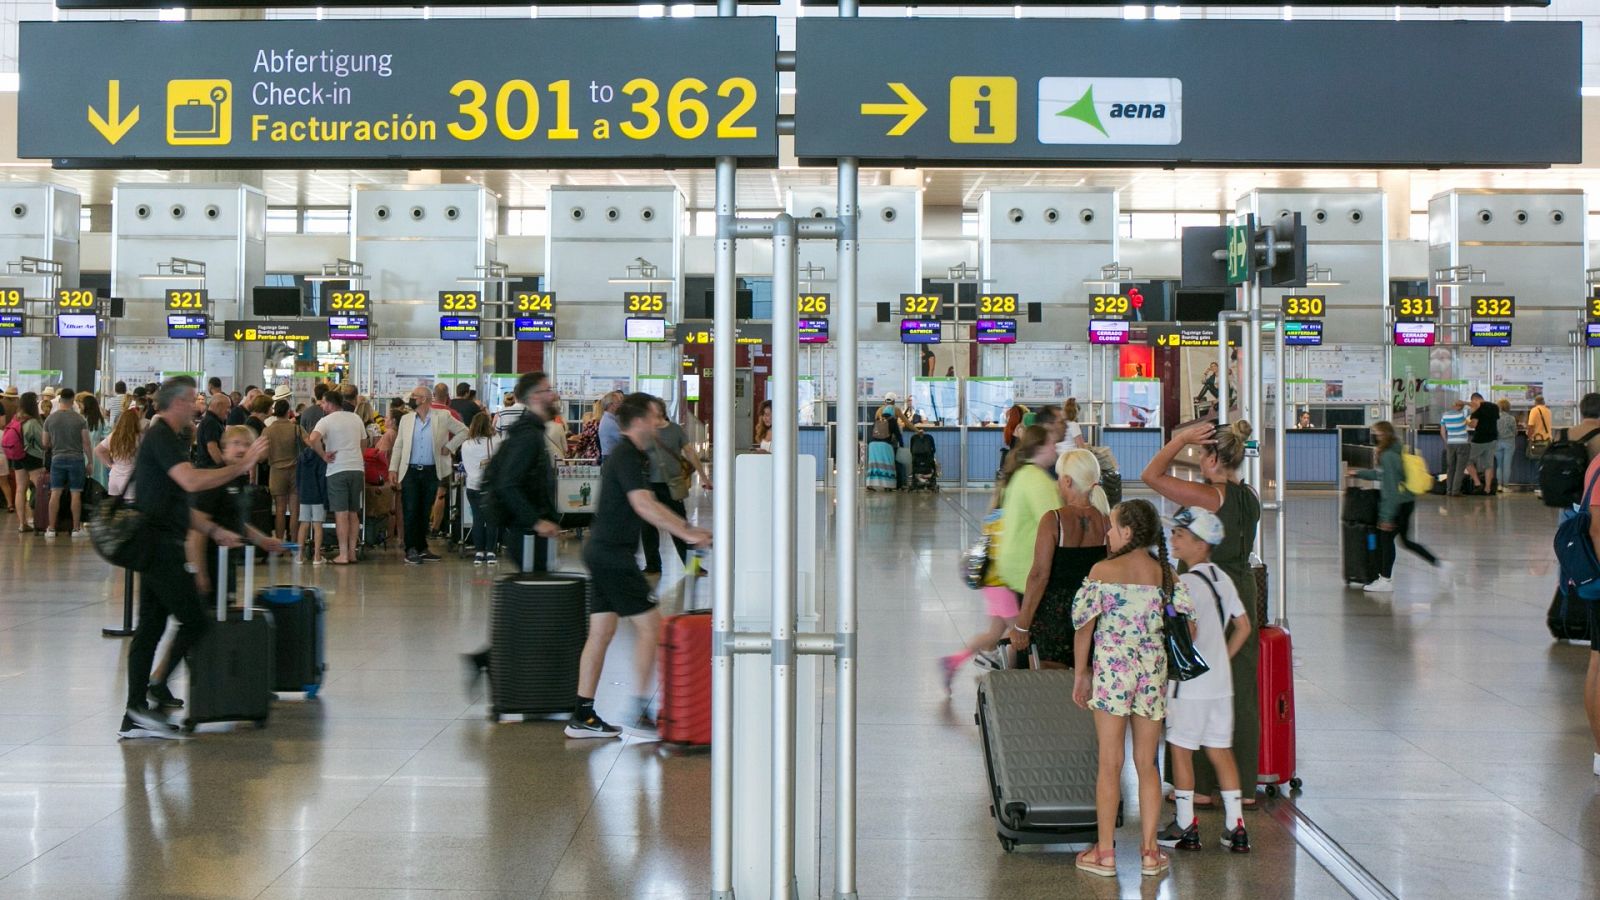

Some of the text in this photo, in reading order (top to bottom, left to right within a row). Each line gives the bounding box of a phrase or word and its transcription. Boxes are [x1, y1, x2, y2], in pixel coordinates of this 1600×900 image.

[253, 48, 393, 78] Abfertigung
[252, 81, 352, 106] Check-in
[589, 80, 614, 103] to
[446, 79, 579, 141] 301
[618, 77, 758, 141] 362
[1109, 103, 1166, 120] aena
[251, 114, 436, 142] Facturación
[591, 119, 610, 141] a
[0, 290, 20, 308] 19
[59, 291, 95, 308] 320
[169, 291, 203, 309] 321
[331, 293, 366, 311] 322
[443, 294, 478, 311] 323
[517, 294, 553, 312] 324
[629, 295, 664, 312] 325
[904, 296, 939, 314] 327
[980, 296, 1016, 314] 328
[1093, 296, 1129, 314] 329
[1287, 298, 1323, 315] 330
[1399, 298, 1434, 316] 331
[1475, 299, 1512, 316] 332
